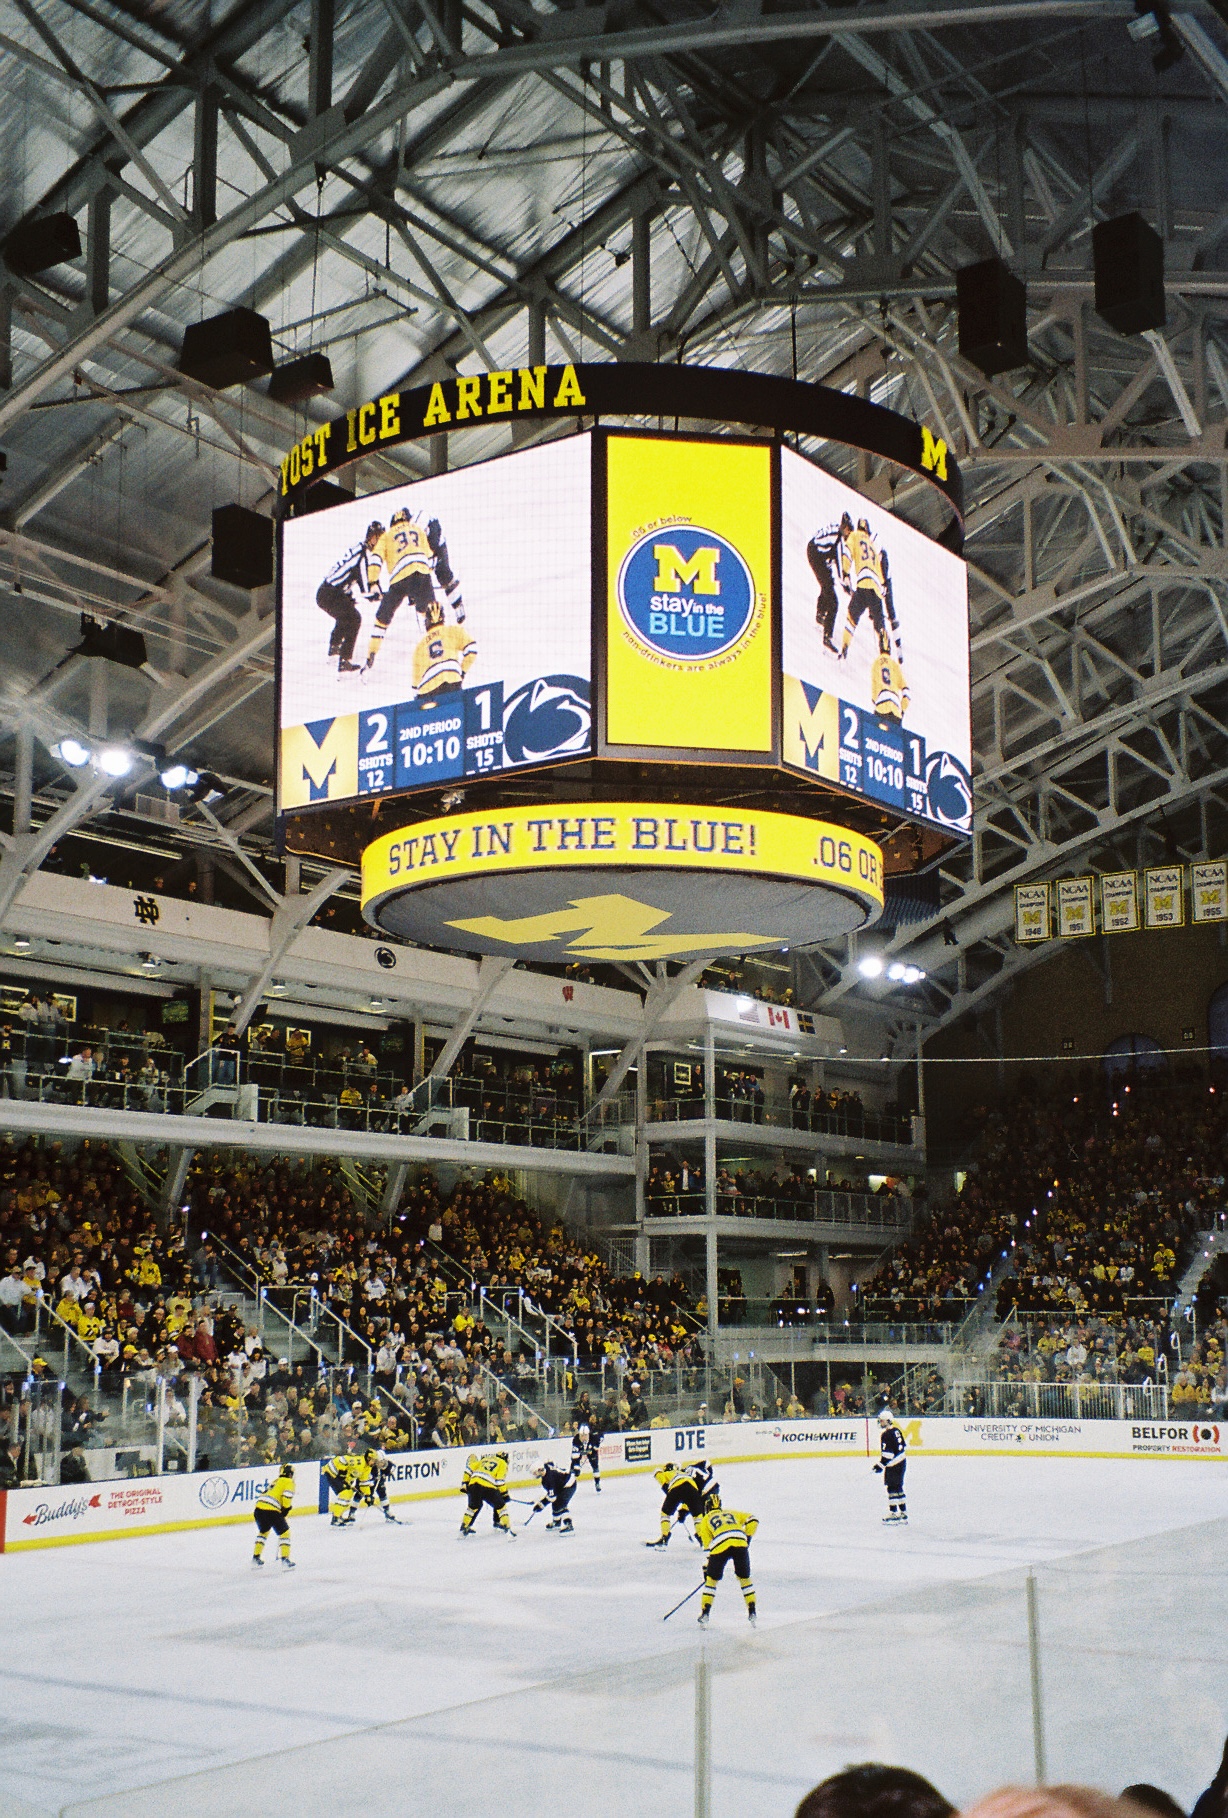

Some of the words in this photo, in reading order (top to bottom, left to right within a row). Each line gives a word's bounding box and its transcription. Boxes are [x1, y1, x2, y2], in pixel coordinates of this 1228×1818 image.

[280, 422, 331, 496] YOST
[346, 392, 401, 453] ICE
[423, 364, 586, 428] ARENA
[921, 425, 948, 482] M
[653, 544, 721, 596] M
[650, 593, 694, 617] stay
[705, 603, 725, 616] the
[650, 612, 725, 639] BLUE
[474, 691, 492, 730] 1
[365, 713, 389, 753] 2
[399, 726, 422, 741] 2ND
[422, 717, 462, 736] PERIOD
[843, 708, 859, 750] 2
[466, 731, 504, 750] SHOTS
[358, 753, 394, 772] SHOTS
[400, 736, 461, 769] 10:10
[475, 748, 494, 768] 15
[839, 747, 863, 768] SHOTS
[909, 739, 921, 776] 1
[366, 769, 385, 788] 12
[844, 764, 858, 784] 12
[866, 755, 904, 790] 10:10
[910, 792, 924, 811] 15
[388, 829, 462, 876] STAY
[471, 822, 514, 858] IN
[527, 817, 617, 851] THE
[630, 818, 756, 856] BLUE!
[813, 836, 852, 873] .06
[1149, 874, 1178, 884] NCAA
[1195, 868, 1225, 878] NCAA
[1019, 890, 1046, 900] NCAA
[1061, 885, 1088, 896] NCAA
[1105, 879, 1133, 890] NCAA
[963, 1425, 1018, 1433] UNIVERSITY
[1020, 1425, 1034, 1433] OF
[1035, 1425, 1082, 1434] MICHIGAN
[981, 1433, 1015, 1441] CREDIT
[1028, 1433, 1060, 1442] UNION
[1131, 1427, 1189, 1440] BELFOR
[675, 1430, 706, 1451] DTE
[110, 1491, 124, 1499] THE
[125, 1488, 162, 1498] ORIGINAL
[34, 1498, 89, 1526] Buddy's
[124, 1506, 146, 1516] PIZZA
